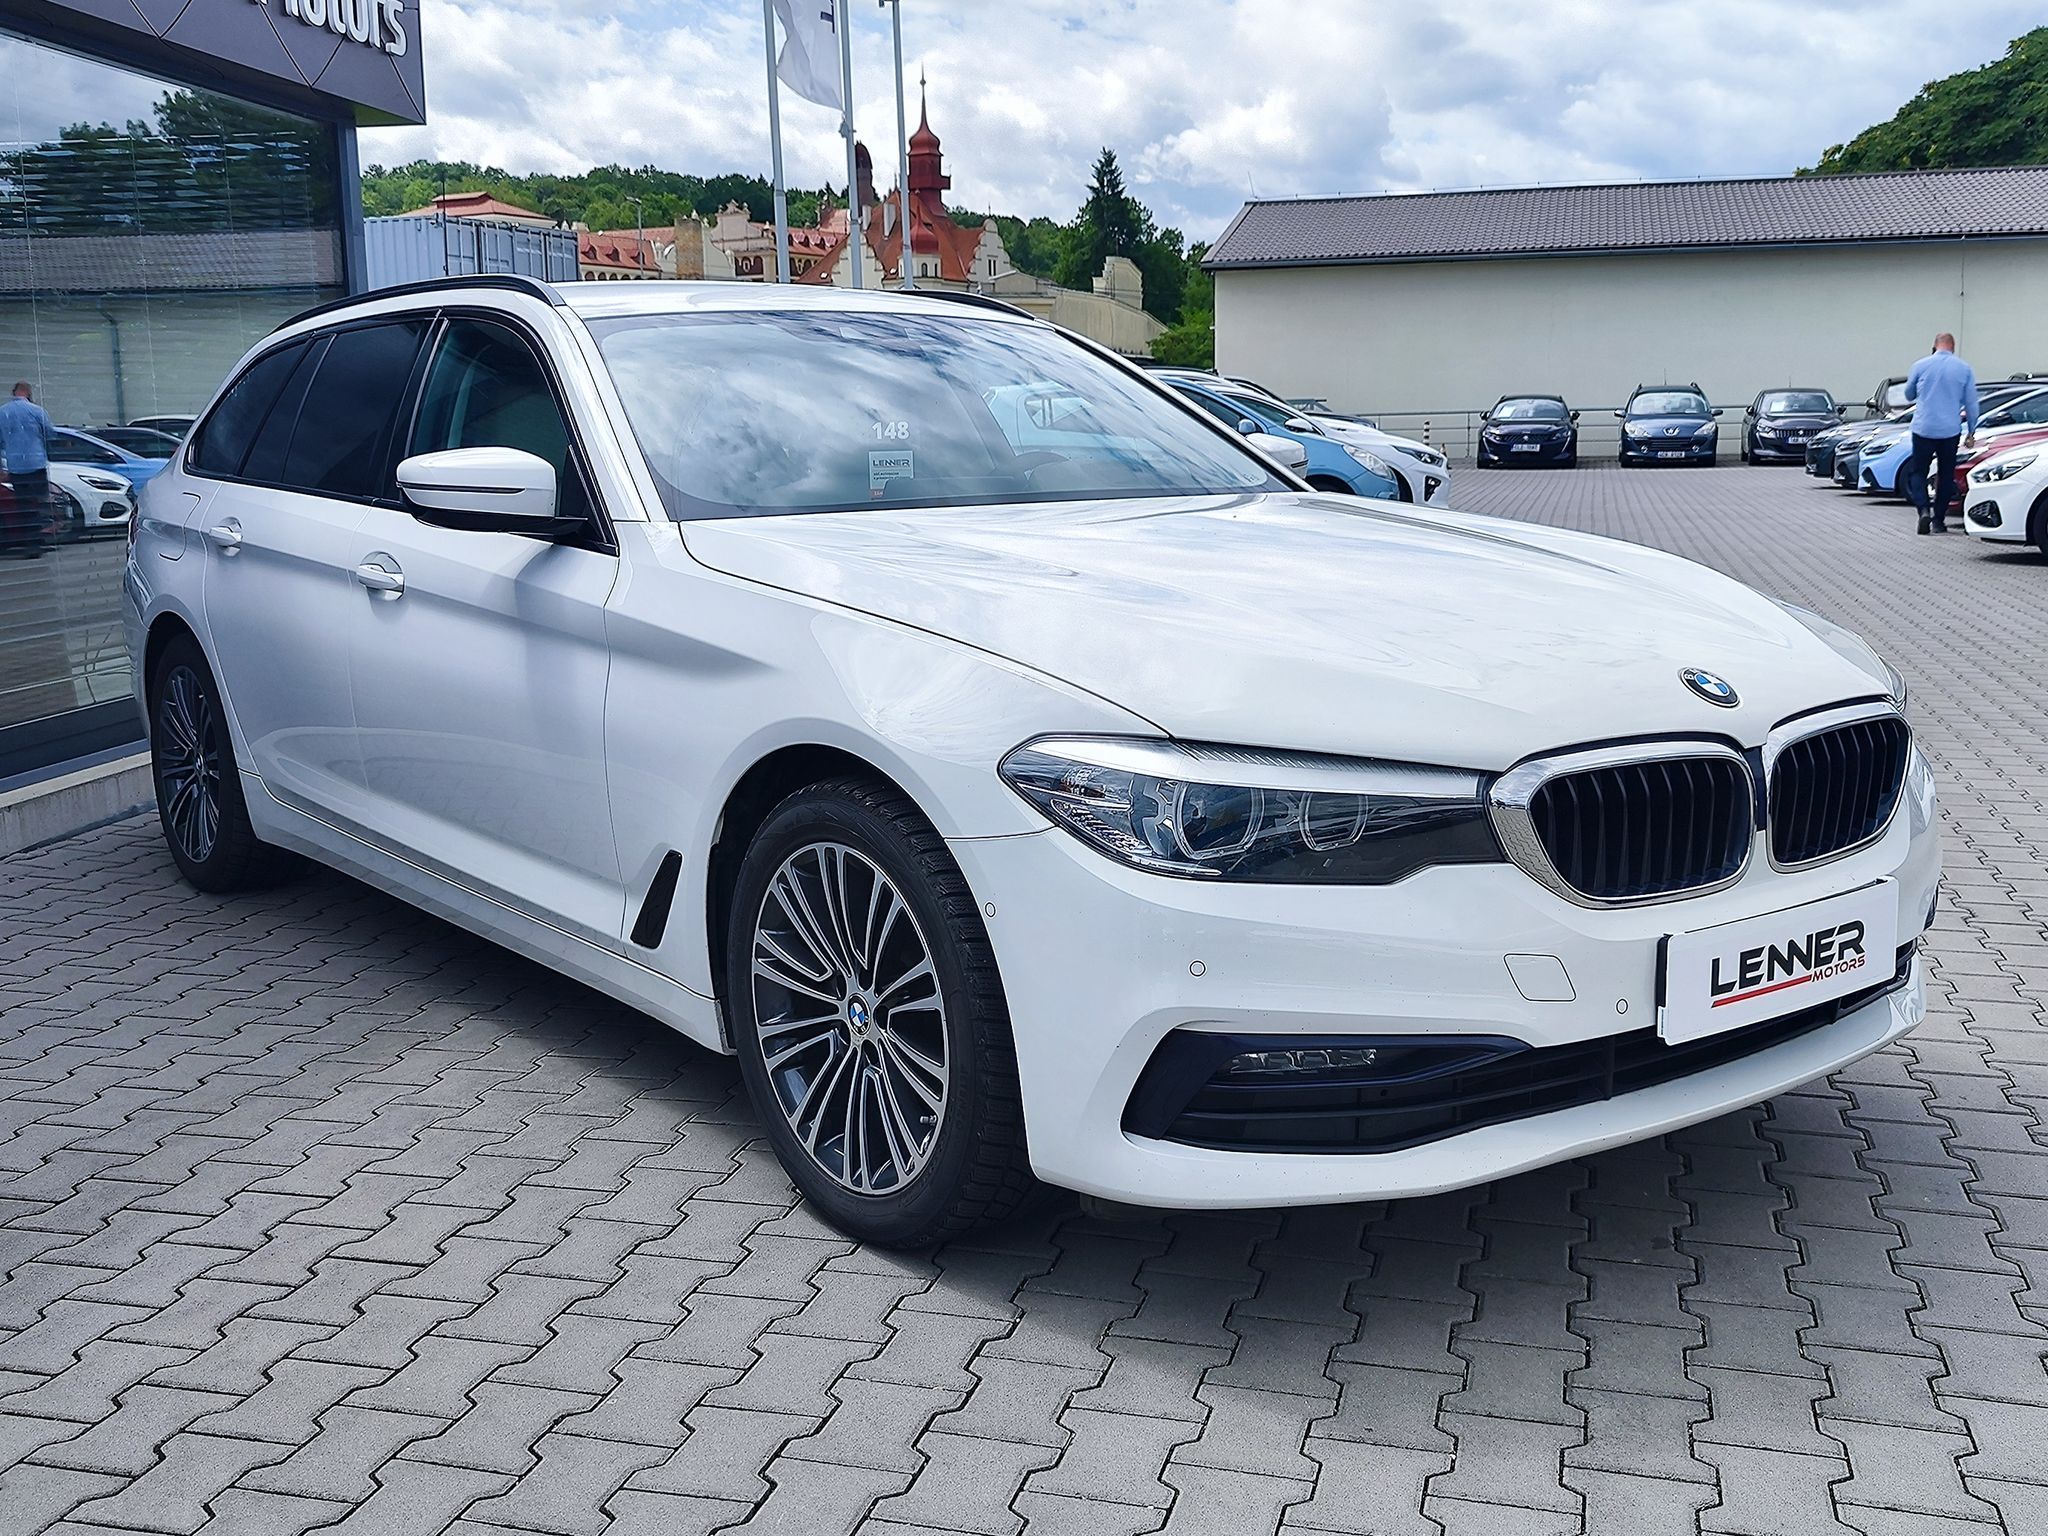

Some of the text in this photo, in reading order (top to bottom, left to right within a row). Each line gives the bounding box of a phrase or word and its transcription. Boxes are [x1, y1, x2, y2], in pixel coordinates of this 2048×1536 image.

[250, 0, 408, 57] ors
[872, 421, 910, 440] 148
[1710, 919, 1866, 997] LENNER
[1811, 953, 1867, 983] MOTORS
